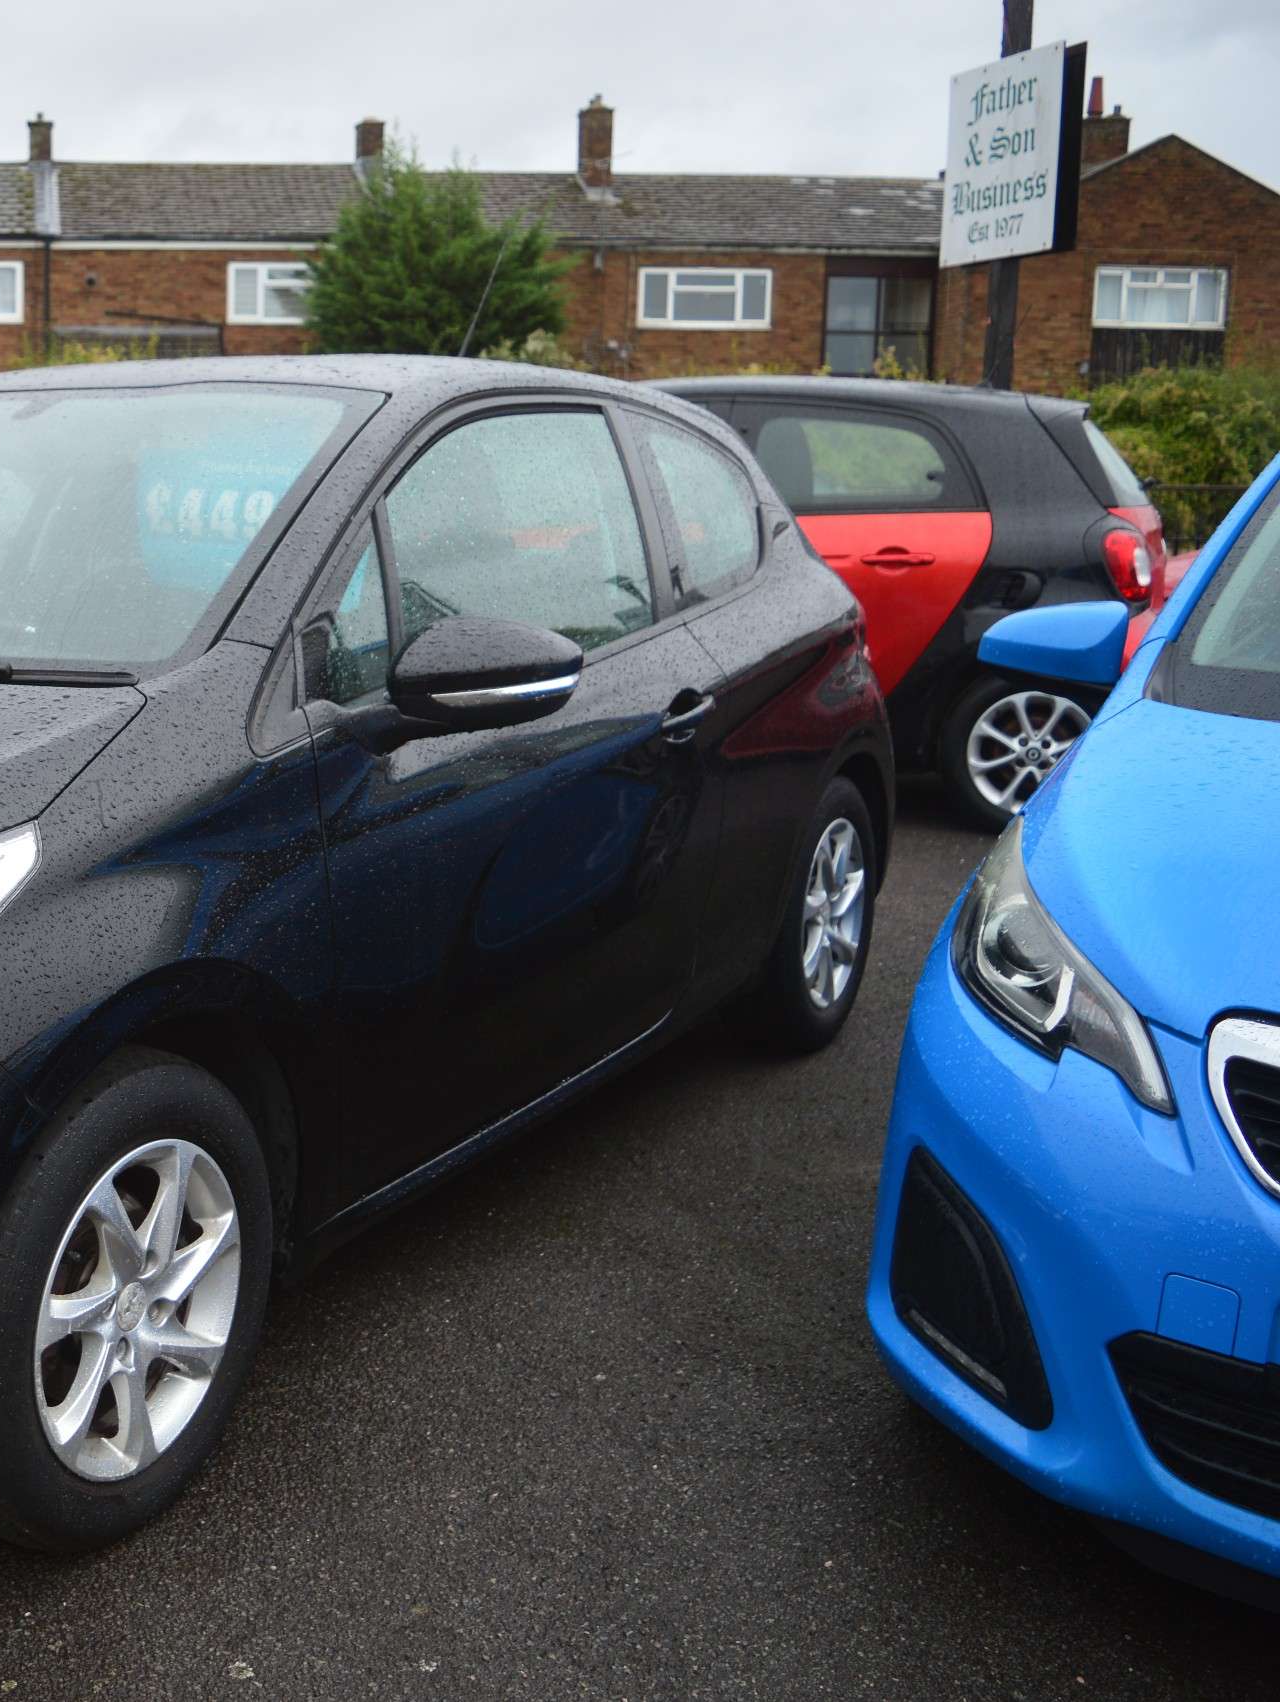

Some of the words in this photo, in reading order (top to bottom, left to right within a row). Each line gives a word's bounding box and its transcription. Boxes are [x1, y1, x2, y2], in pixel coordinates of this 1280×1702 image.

[967, 76, 1038, 126] Father
[964, 132, 983, 168] &
[989, 126, 1036, 161] Son
[952, 168, 1048, 215] Business
[968, 221, 989, 244] Est
[995, 213, 1024, 239] 1977
